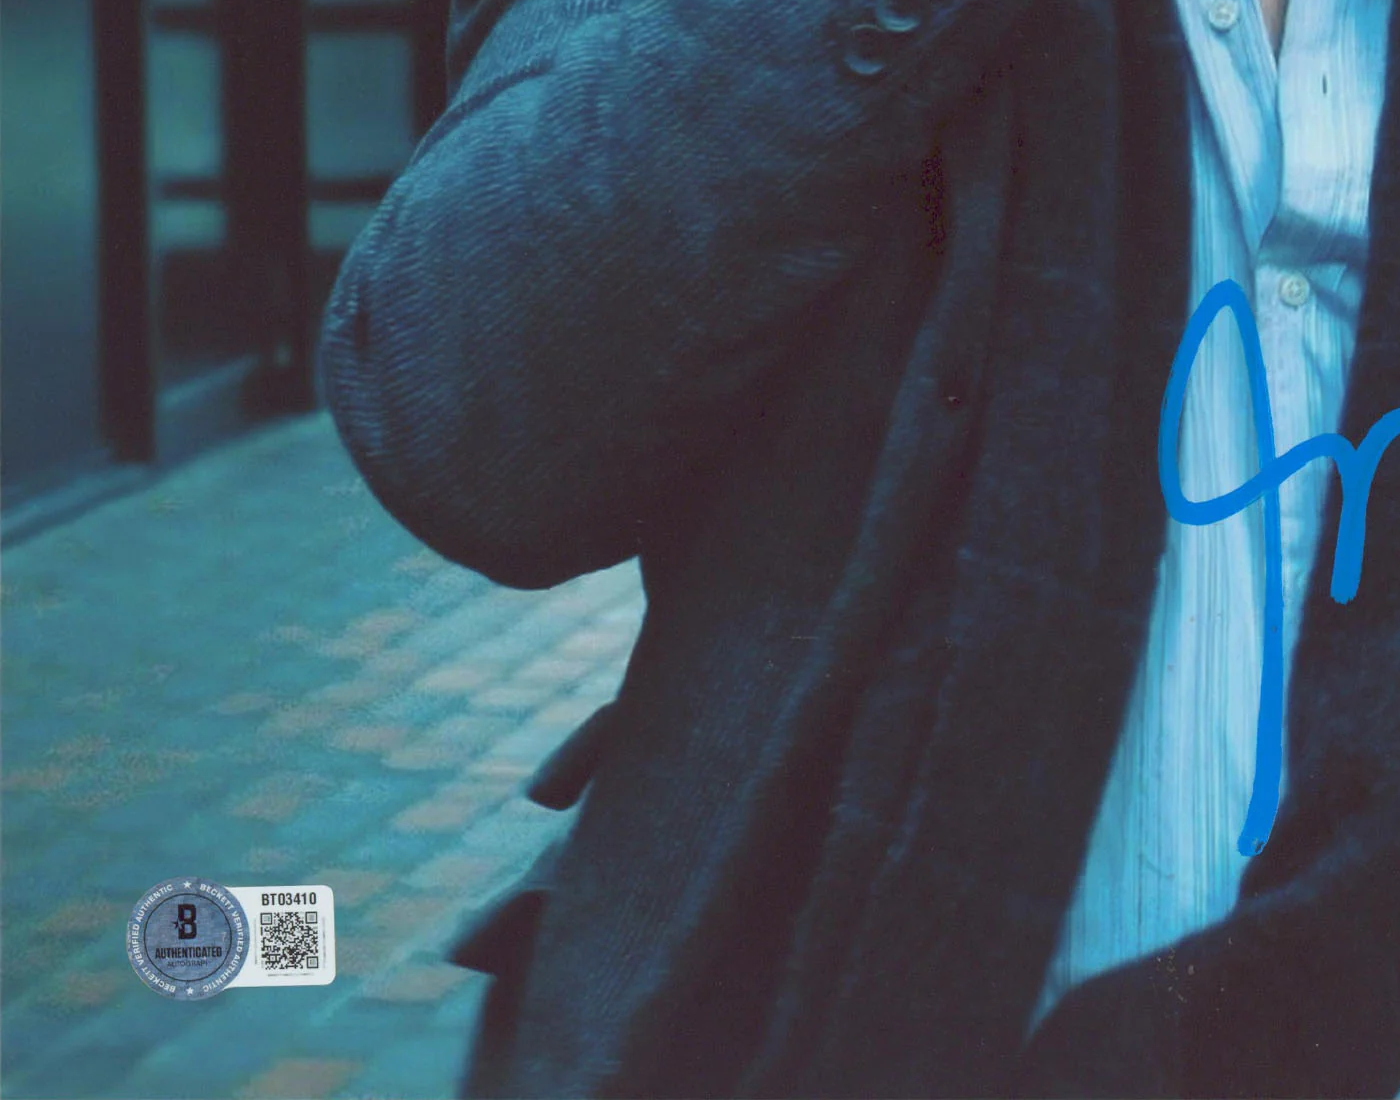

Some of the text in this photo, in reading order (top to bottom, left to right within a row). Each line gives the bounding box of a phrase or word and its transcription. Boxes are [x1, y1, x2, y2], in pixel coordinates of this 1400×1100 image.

[261, 891, 317, 906] BT03410
[131, 883, 176, 993] BECKETT VERIFIED AUTHENTIC
[155, 946, 222, 959] AUTHENTICATED
[199, 883, 244, 993] BECKETT VERIFIED AUTHENTIC
